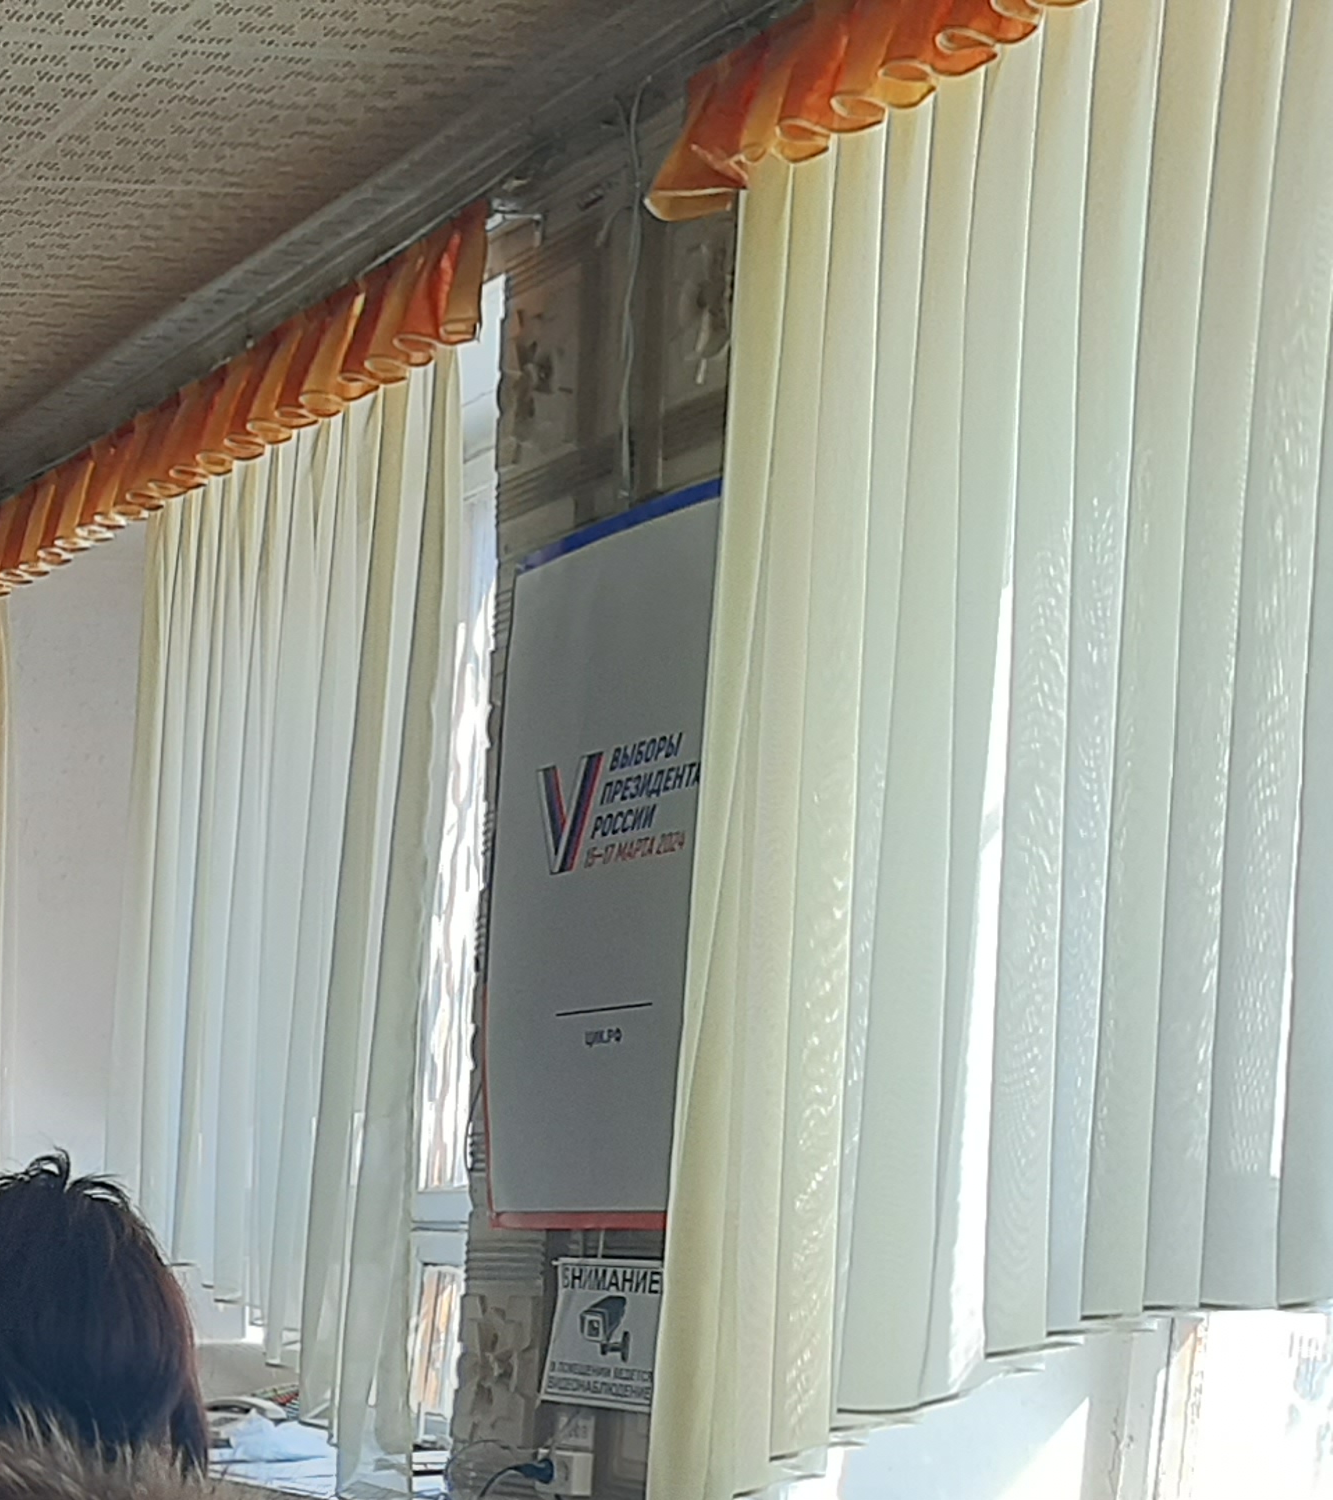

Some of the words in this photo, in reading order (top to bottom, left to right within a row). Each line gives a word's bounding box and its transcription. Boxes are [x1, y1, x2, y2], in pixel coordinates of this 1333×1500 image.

[609, 732, 683, 772] ВЫБОРЫ
[599, 761, 702, 806] ПРЕЗИДЕНТА
[590, 803, 658, 840] РОССИИ
[614, 836, 656, 862] МАРТА
[656, 830, 687, 856] 2024
[584, 1027, 622, 1048] ЦИК.РФ
[562, 1266, 663, 1295] ВНИМАНИЕ
